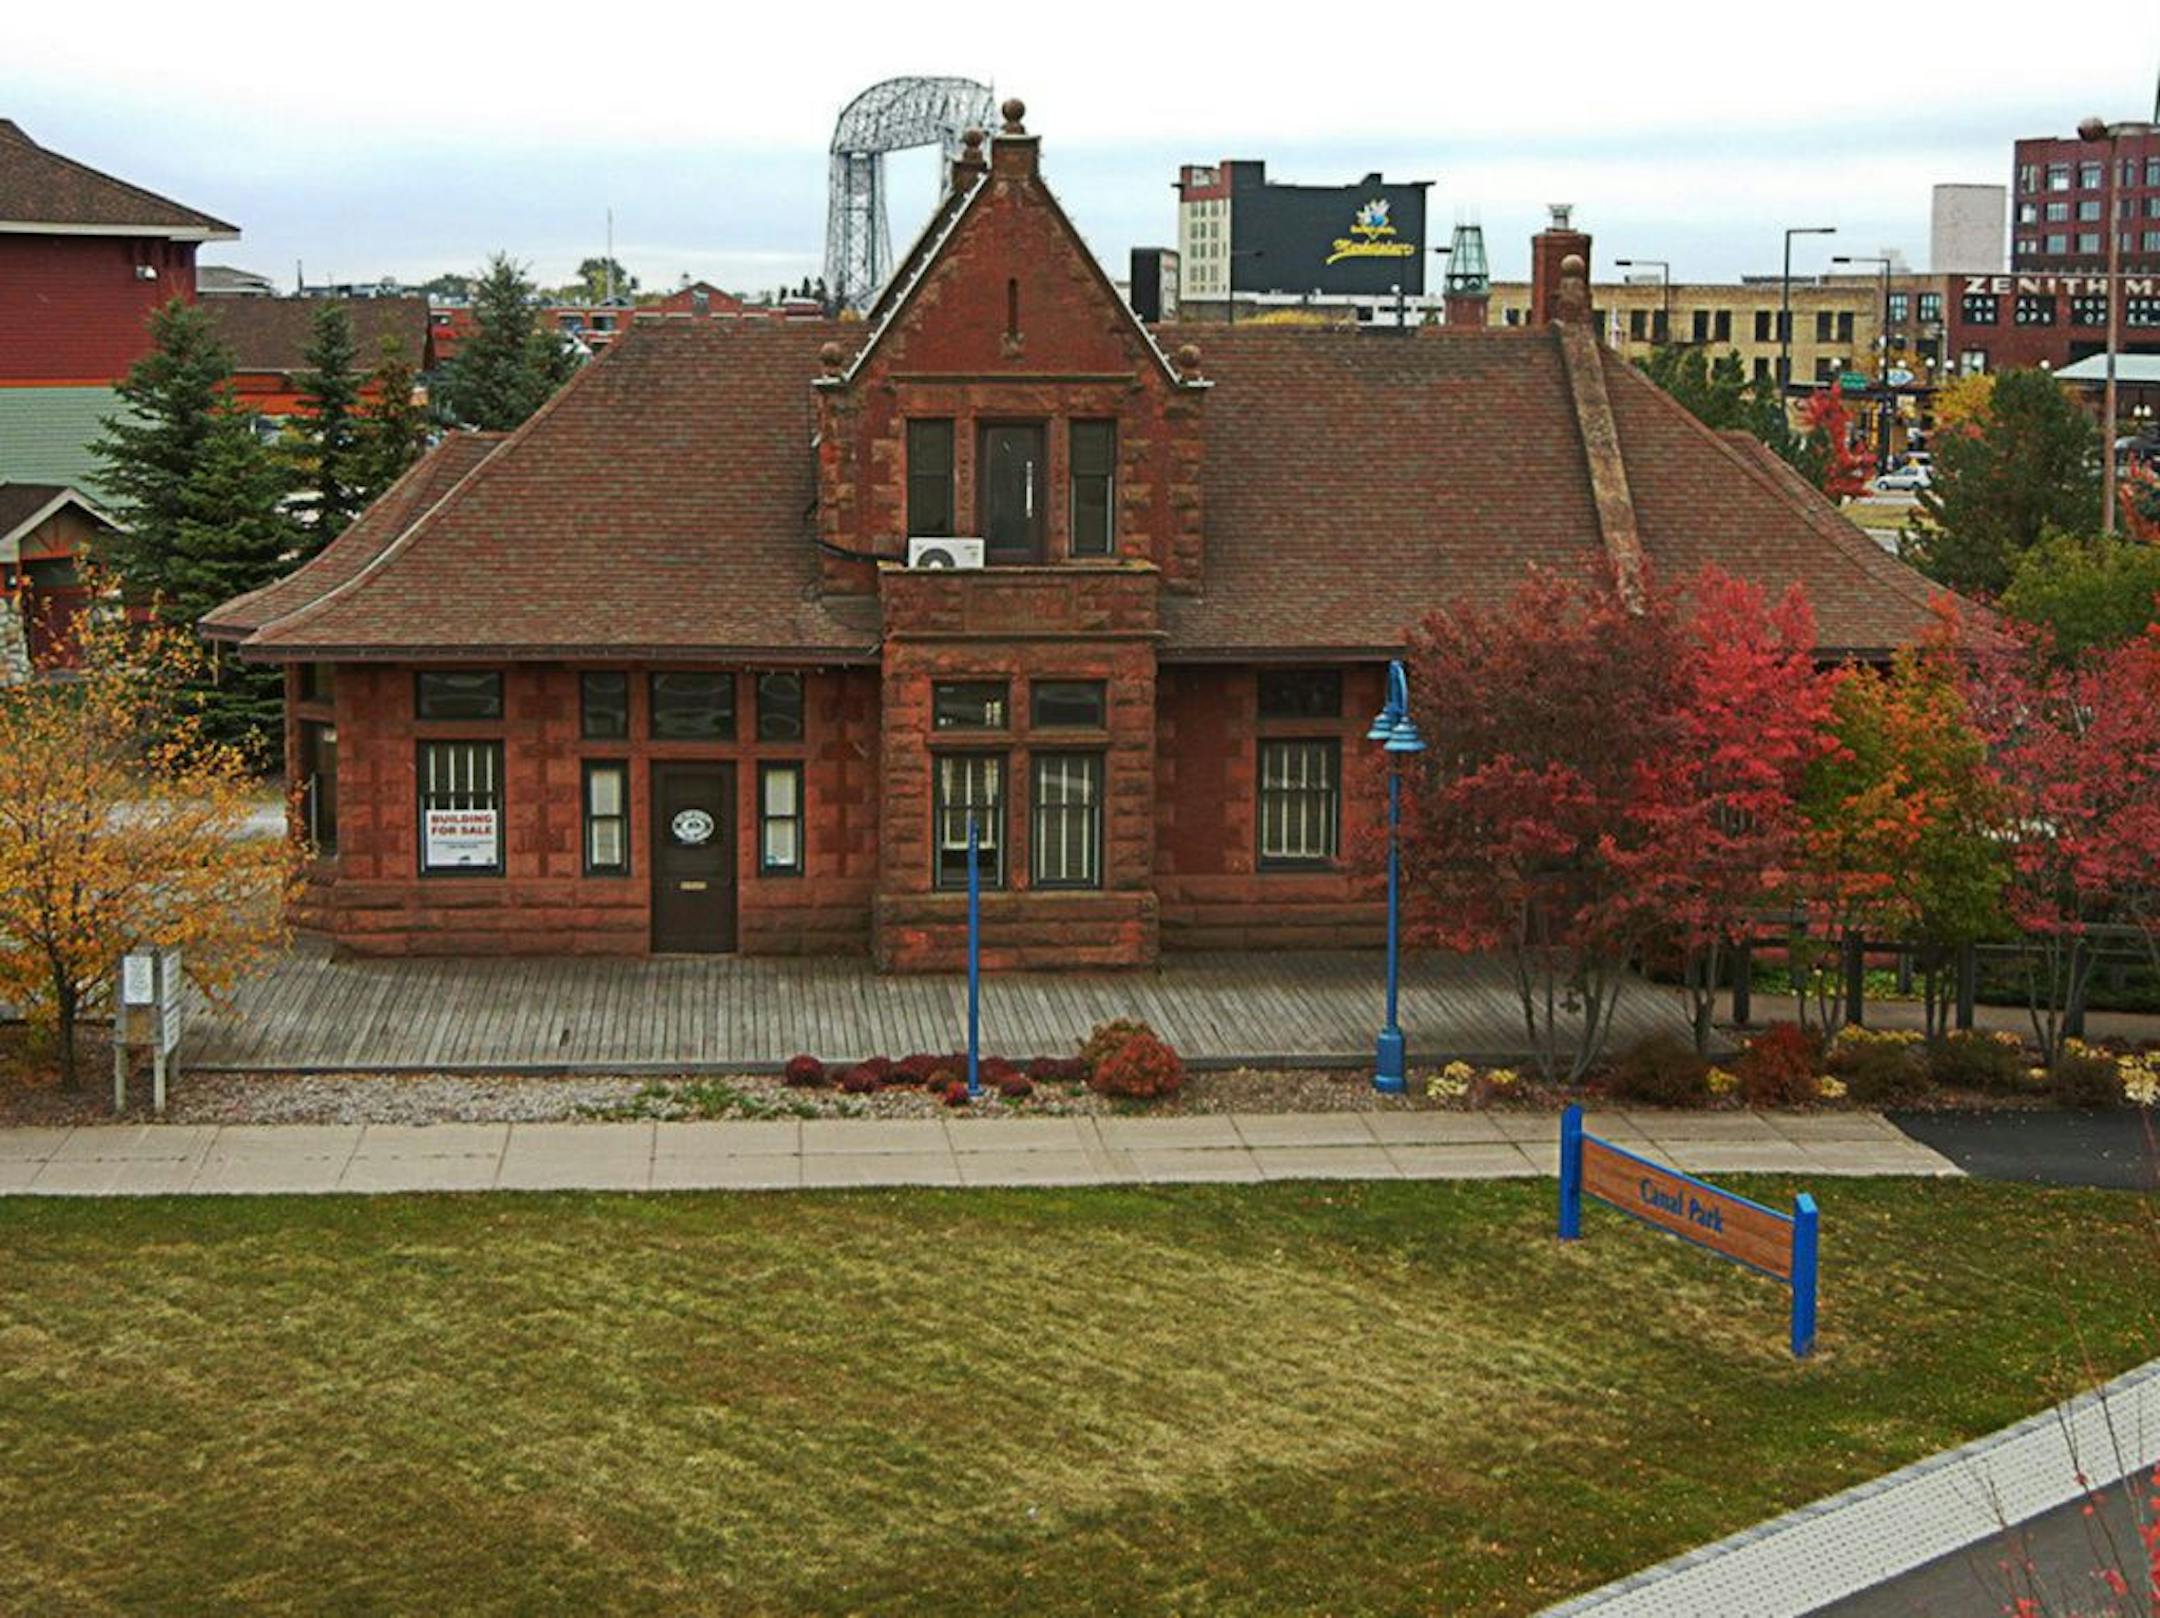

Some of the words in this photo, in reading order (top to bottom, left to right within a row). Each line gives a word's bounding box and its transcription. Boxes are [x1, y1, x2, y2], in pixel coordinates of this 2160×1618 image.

[1964, 276, 2108, 295] ZENITH
[431, 813, 493, 823] BUILDING
[431, 826, 457, 835] FOR
[461, 826, 493, 835] SALE
[1639, 1178, 1684, 1216] Canal
[1688, 1197, 1724, 1233] Park
